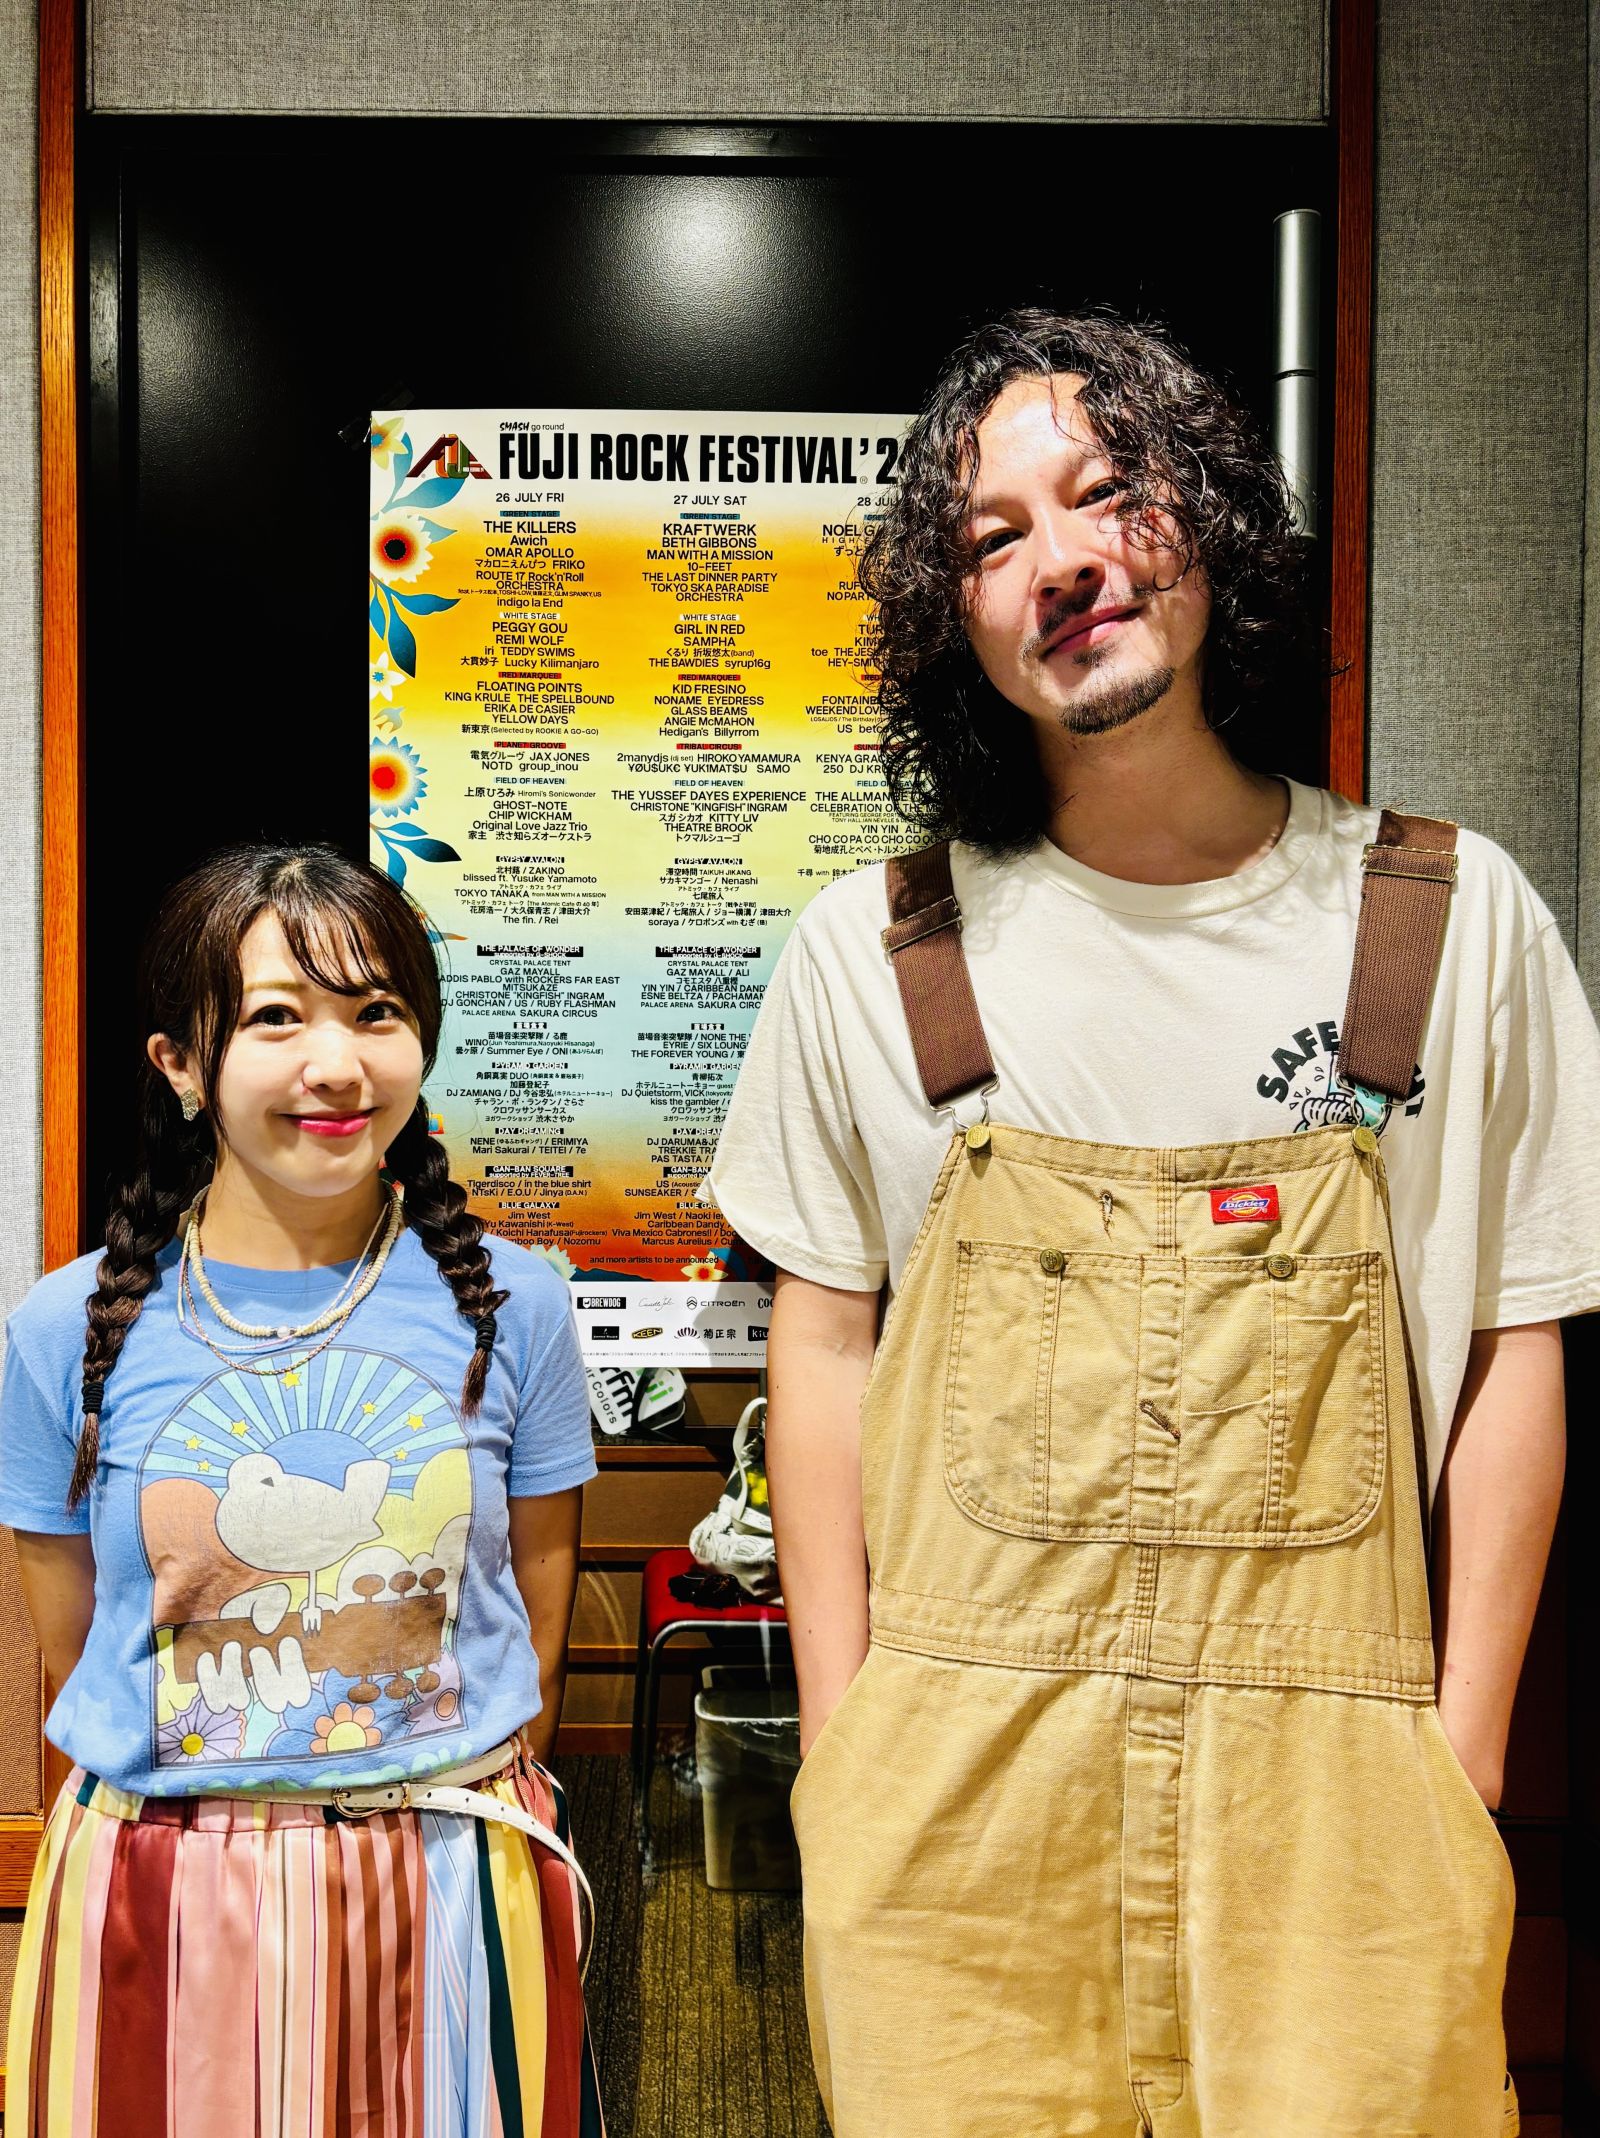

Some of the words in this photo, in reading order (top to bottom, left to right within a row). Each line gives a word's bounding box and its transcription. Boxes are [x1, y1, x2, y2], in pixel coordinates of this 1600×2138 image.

[499, 421, 529, 431] SMASH
[531, 424, 540, 432] go
[500, 433, 578, 480] FUJI
[591, 433, 689, 482] ROCK
[700, 434, 898, 485] FESTIVAL'2
[495, 492, 510, 502] 26
[514, 492, 542, 502] JULY
[546, 492, 563, 502] FRI
[673, 494, 687, 504] 27
[691, 495, 719, 504] JULY
[723, 495, 746, 505] SAT
[857, 497, 871, 507] 28
[483, 520, 512, 533] THE
[517, 521, 576, 533] KILLERS
[663, 523, 756, 536] KRAFTWERK
[822, 525, 861, 536] NOEL
[510, 534, 547, 545] Awich
[662, 536, 695, 548] BETH
[698, 537, 756, 548] GIBBONS
[485, 547, 522, 557] OMAR
[525, 548, 574, 558] APOLLO
[646, 549, 674, 559] MAN
[677, 549, 708, 560] WITH
[710, 550, 719, 560] A
[721, 550, 773, 560] MISSION
[474, 559, 546, 569] マカロニえんぴつ
[552, 559, 585, 569] FRIKO
[687, 561, 732, 571] 10-FEET
[641, 572, 663, 581] THE
[666, 572, 695, 581] LAST
[698, 572, 738, 581] DINNER
[741, 572, 777, 581] PARTY
[497, 596, 529, 608] indigo
[531, 597, 540, 607] la
[542, 598, 563, 607] End
[492, 621, 535, 632] PEGGY
[538, 622, 567, 633] GOU
[674, 623, 702, 634] GIRL
[705, 624, 717, 634] IN
[720, 624, 745, 634] RED
[683, 636, 735, 646] SAMPHA
[484, 645, 494, 655] iri
[500, 646, 535, 656] TEDDY
[537, 647, 575, 657] SWIMS
[666, 647, 688, 657] くるり
[811, 648, 828, 656] toe
[460, 656, 498, 666] 大貫妙子
[505, 657, 537, 669] Lucky
[540, 658, 599, 669] Kilimanjaro
[648, 657, 669, 667] THE
[671, 658, 719, 667] BAWDIES
[724, 658, 770, 669] syrup16g
[477, 680, 535, 691] FLOATING
[538, 682, 582, 692] POINTS
[672, 684, 692, 694] KID
[694, 684, 746, 694] FRESINO
[444, 691, 471, 701] KING
[474, 692, 510, 702] KRULE
[517, 693, 538, 703] THE
[541, 694, 614, 704] SPELLBOUND
[654, 695, 701, 704] NONAME
[707, 695, 764, 705] EYEDRESS
[805, 705, 859, 714] WEEKEND
[492, 714, 537, 723] YELLOW
[540, 715, 568, 724] DAYS
[664, 716, 696, 725] ANGIE
[698, 717, 754, 726] McMAHON
[659, 727, 708, 738] Hedigan's
[714, 727, 759, 738] Billyrrom
[470, 750, 525, 760] 電気グルーヴ
[529, 752, 551, 761] JAX
[553, 752, 589, 761] JONES
[697, 753, 737, 762] HIROKO
[737, 753, 800, 762] YAMAMURA
[816, 754, 855, 762] KENYA
[481, 761, 512, 770] NOTD
[519, 763, 578, 772] group_inou
[823, 764, 843, 773] 250
[849, 764, 863, 773] DJ
[464, 786, 515, 797] 上原ひろみ
[611, 790, 634, 800] THE
[638, 790, 686, 800] YUSSEF
[690, 791, 729, 800] DAYES
[732, 791, 806, 801] EXPERIENCE
[493, 800, 567, 810] GHOST-NOTE
[810, 803, 882, 812] CELEBRATION
[488, 810, 514, 819] CHIP
[516, 811, 571, 820] WICKHAM
[473, 821, 512, 832] Original
[515, 821, 540, 830] Love
[542, 822, 566, 830] Jazz
[568, 821, 587, 831] Trio
[664, 822, 712, 832] THEATRE
[714, 823, 752, 832] BROOK
[676, 833, 741, 842] トクマルシューゴ
[692, 891, 724, 900] 七尾旅人
[500, 967, 520, 975] GAZ
[523, 967, 560, 975] MAYALL
[471, 975, 502, 983] PABLO
[526, 975, 572, 983] ROCKERS
[595, 976, 620, 984] EAST
[502, 983, 557, 991] MITSUKAZE
[455, 991, 512, 1000] CHRISTONE
[513, 991, 564, 999] "KINGFISH"
[520, 1009, 559, 1017] SAKURA
[561, 1009, 597, 1017] CIRCUS
[507, 1211, 524, 1219] Jim
[527, 1211, 550, 1219] West
[627, 1255, 652, 1263] artists
[676, 1256, 719, 1264] announced
[592, 1298, 620, 1307] BREWDOG
[633, 1328, 661, 1338] KEEN
[703, 1328, 736, 1339] 菊正宗
[593, 1381, 617, 1423] Colors
